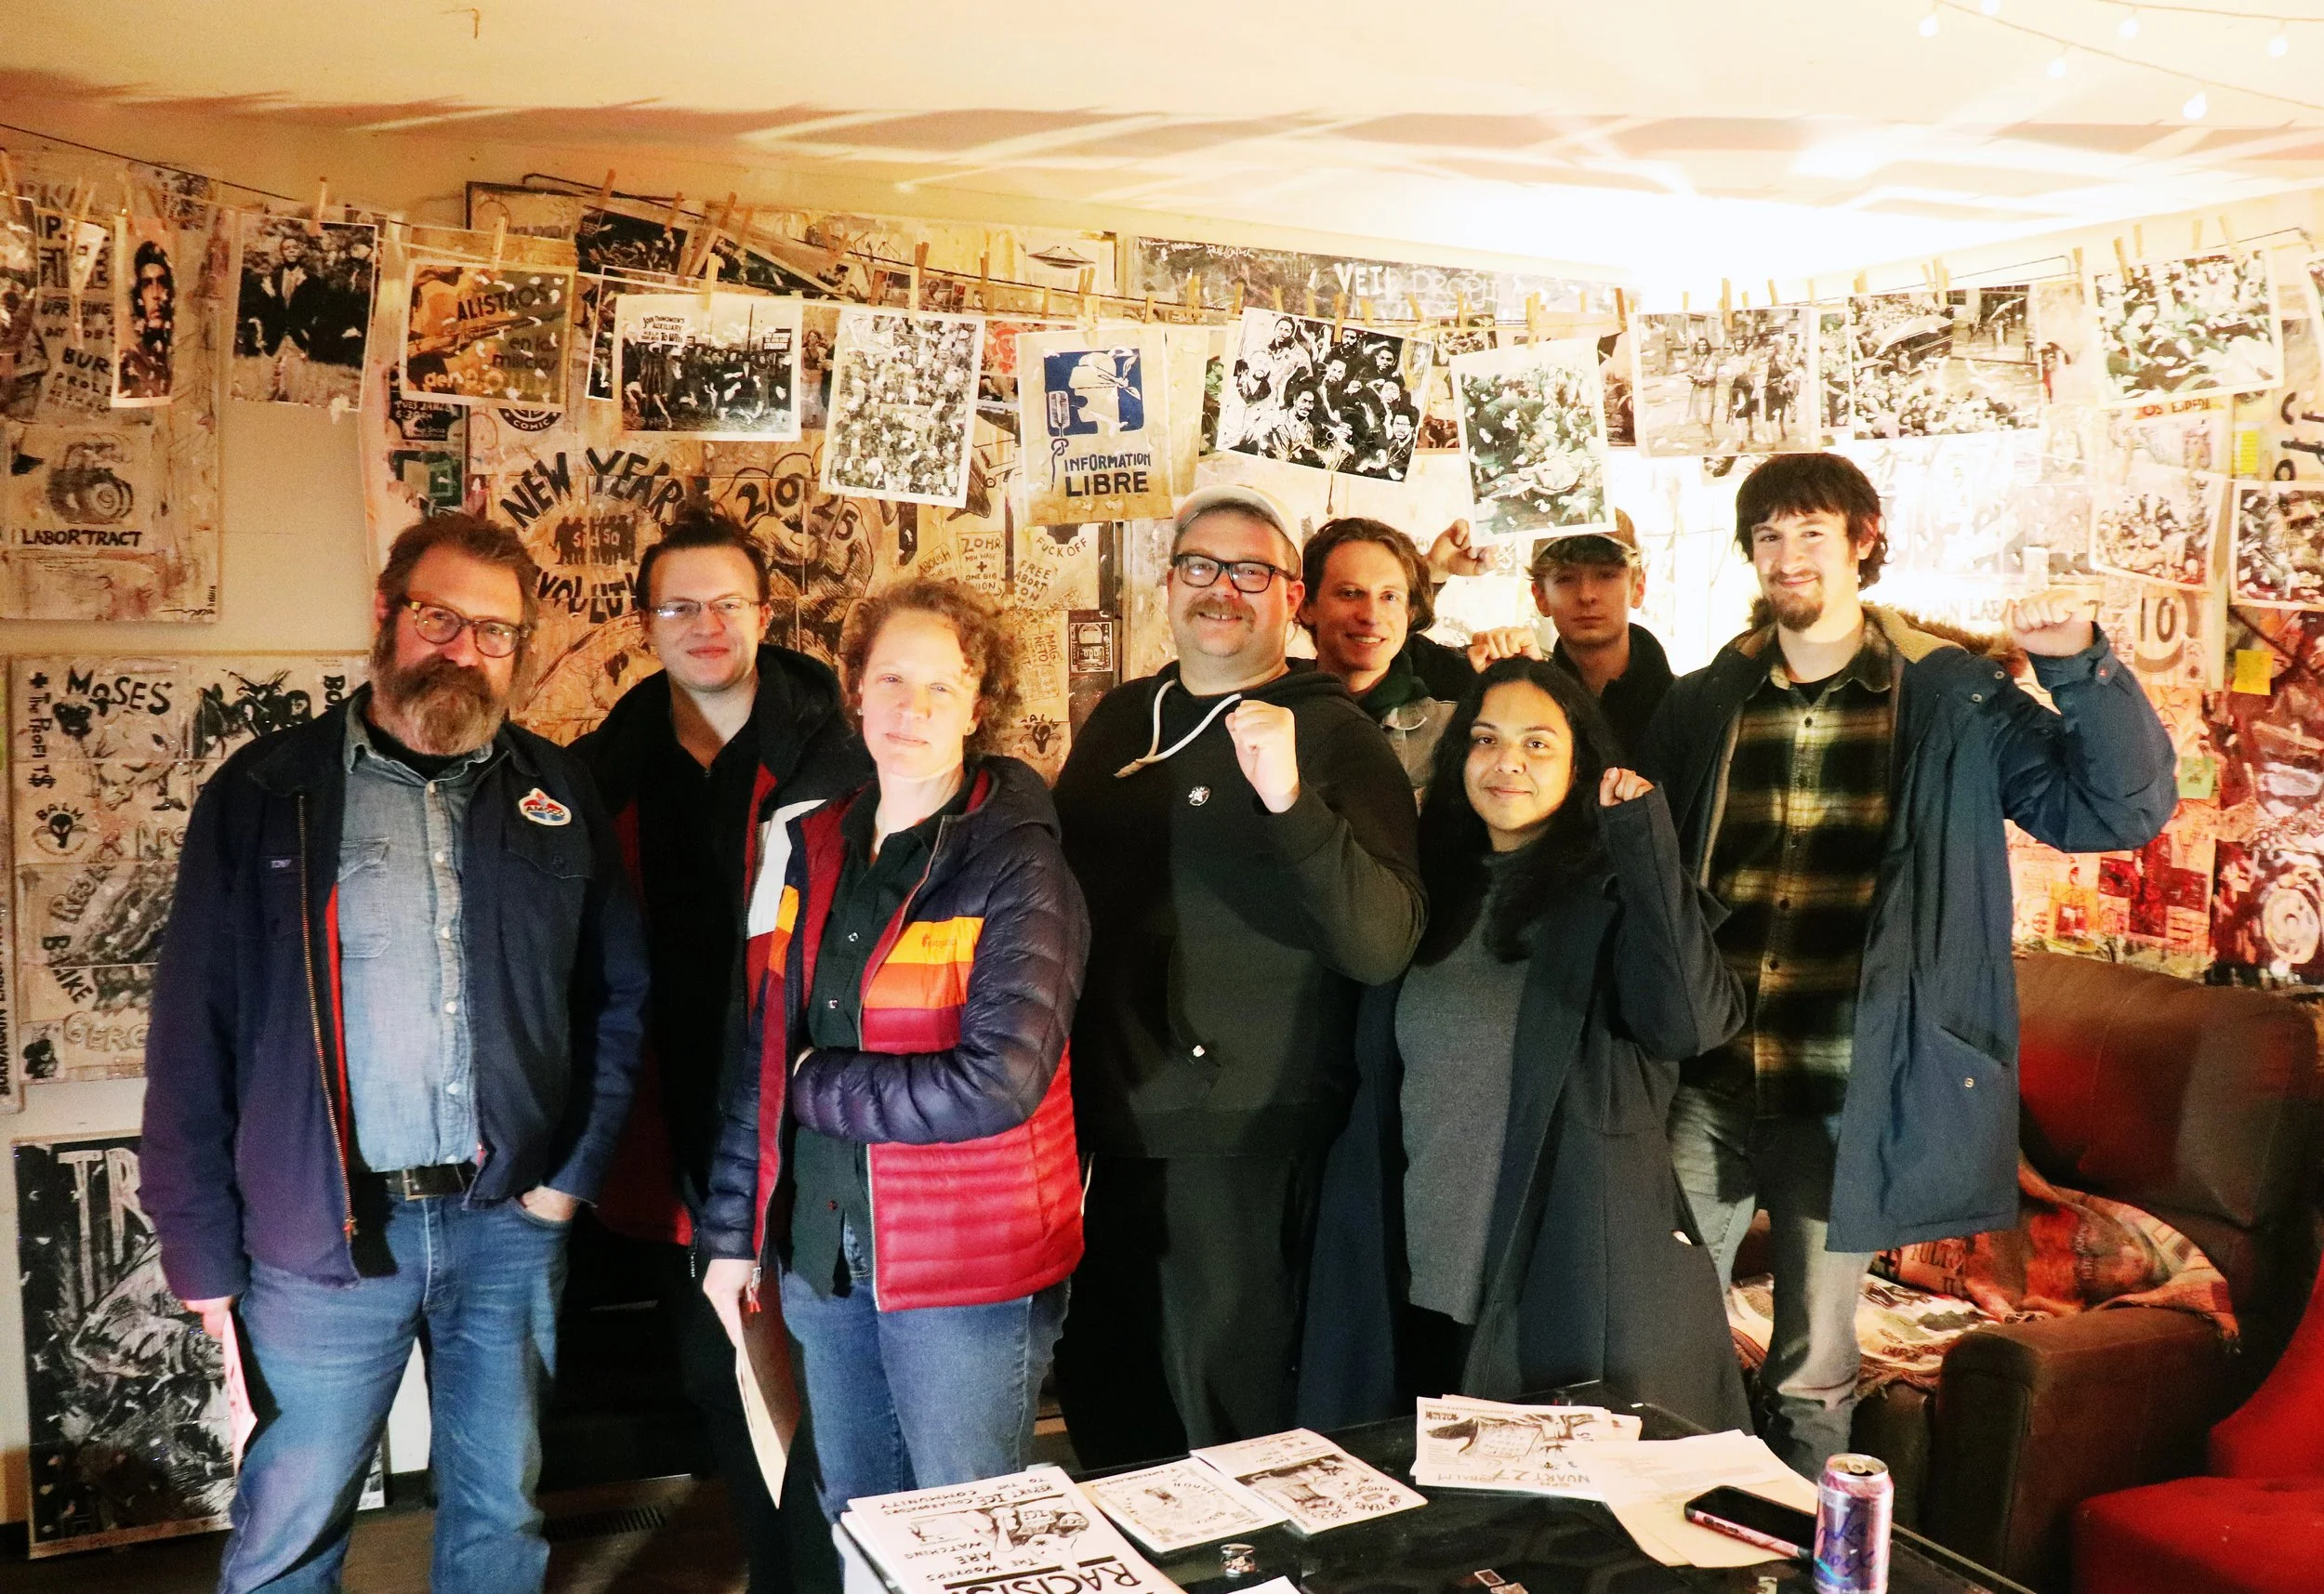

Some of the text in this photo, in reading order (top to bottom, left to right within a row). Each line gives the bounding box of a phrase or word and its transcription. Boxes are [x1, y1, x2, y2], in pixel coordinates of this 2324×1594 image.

[456, 283, 550, 321] ALISTAOS
[513, 419, 550, 431] COMIC
[1064, 453, 1152, 472] INFORMATION
[500, 447, 688, 533] NEW YEAR
[1064, 471, 1150, 498] LIBRE
[735, 472, 859, 541] 2025
[1036, 535, 1089, 558] FUCK OFF
[1018, 560, 1052, 580] FREE
[67, 665, 174, 716] MOSES
[34, 803, 86, 822] BALM
[1536, 1471, 1591, 1483] NUARY
[880, 1489, 977, 1509] COMMUNITY
[977, 1493, 1010, 1507] ICE
[905, 1541, 983, 1560] WATCHING
[954, 1550, 992, 1565] ARE
[925, 1556, 1039, 1582] THE WORKERS
[951, 1562, 1142, 1594] RACIS
